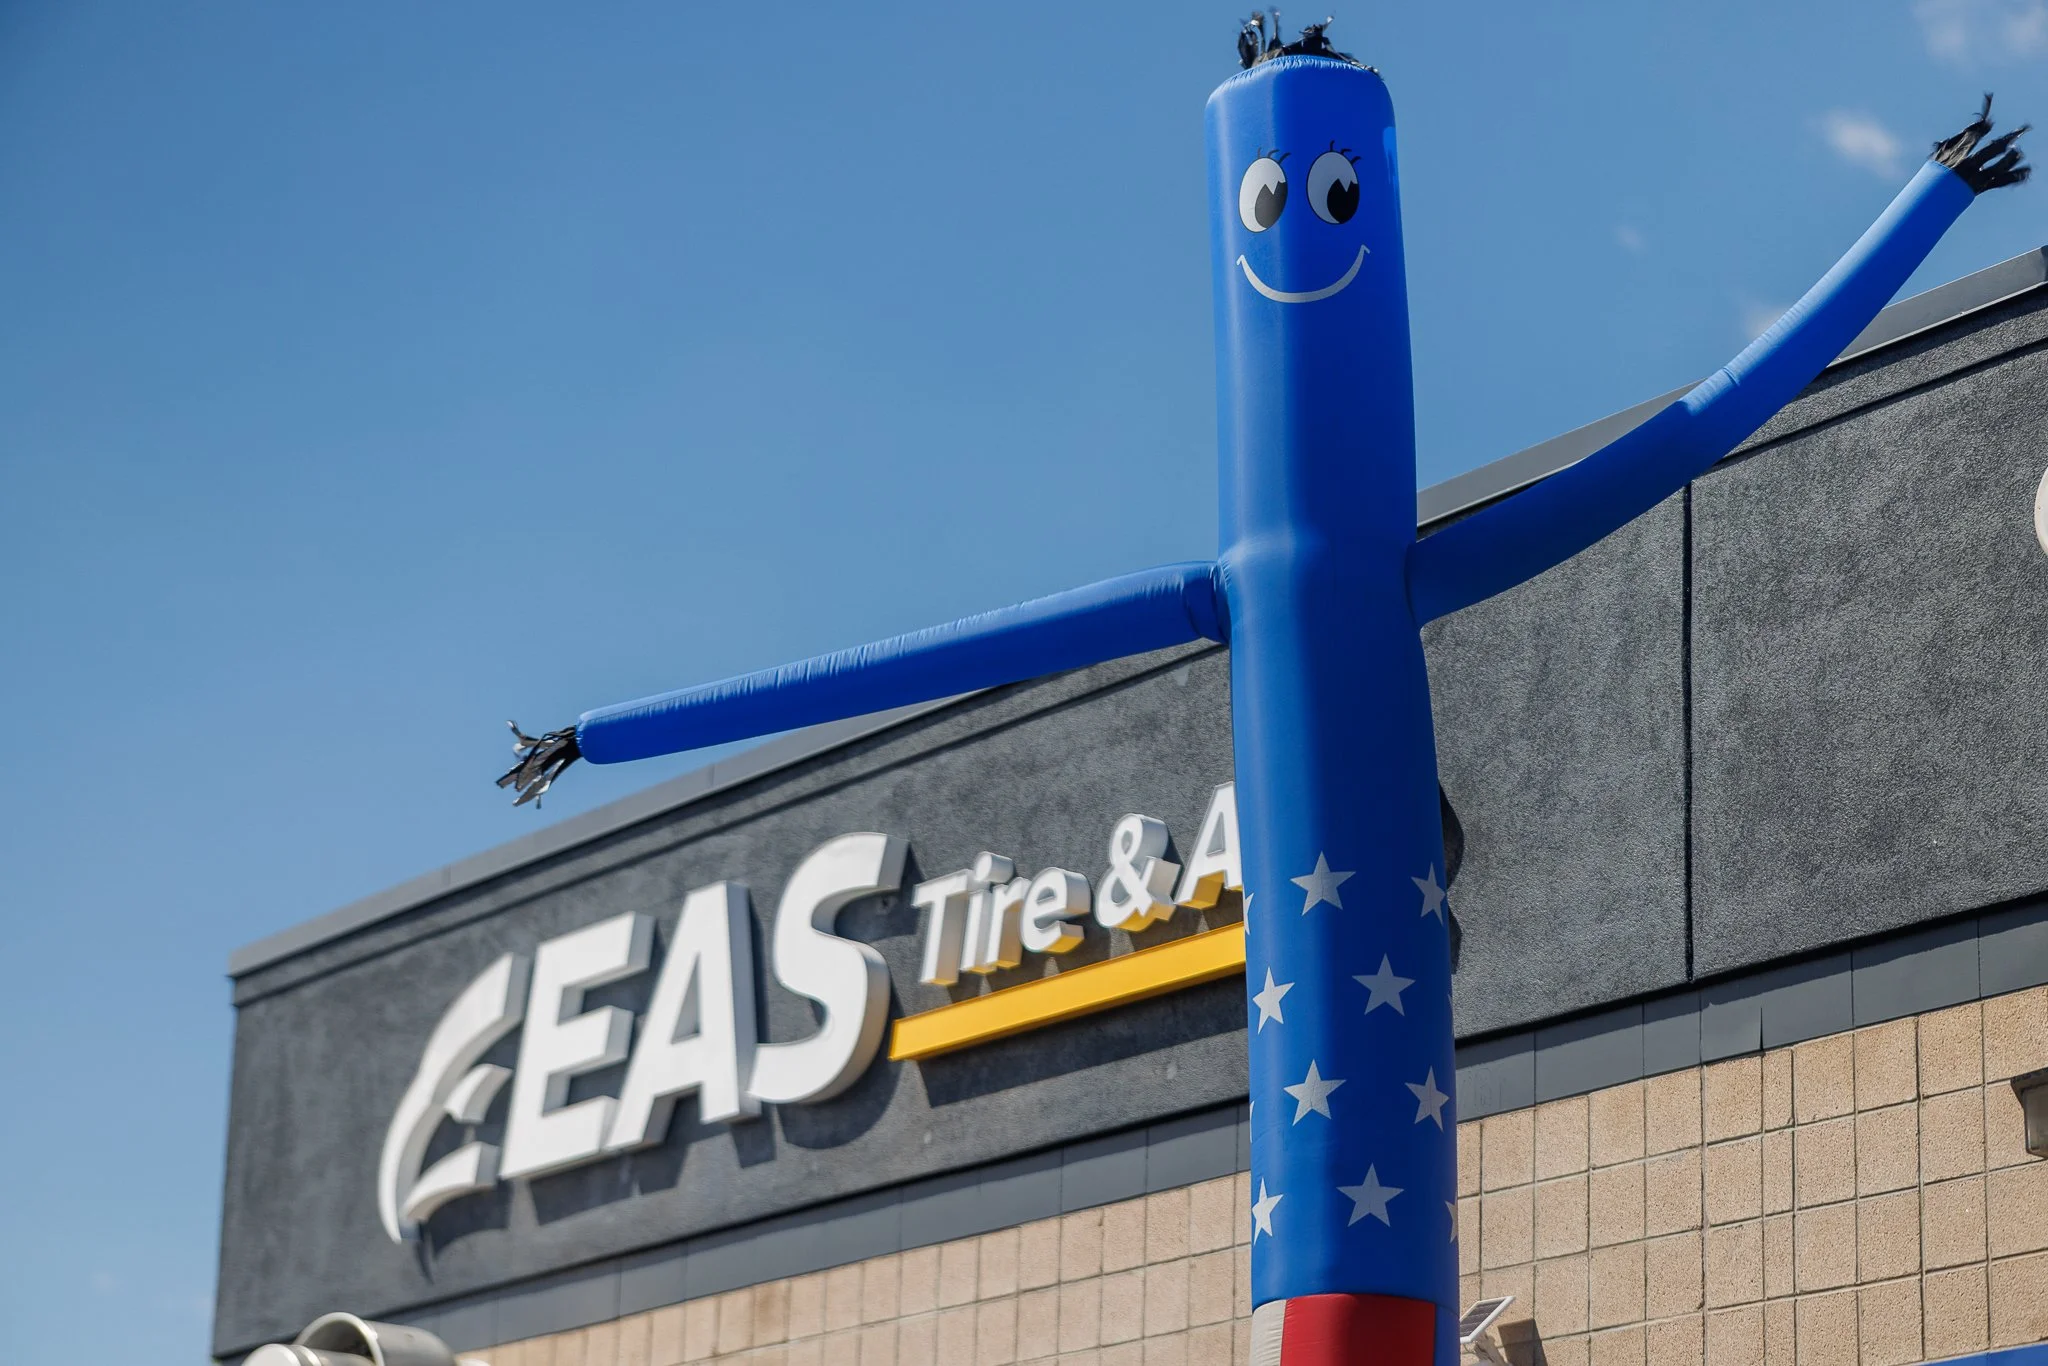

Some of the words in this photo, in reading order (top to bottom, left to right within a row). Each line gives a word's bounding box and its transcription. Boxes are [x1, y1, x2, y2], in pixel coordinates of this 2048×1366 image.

[911, 851, 1091, 986] Tire
[1095, 813, 1182, 932] &
[1173, 781, 1243, 909] A
